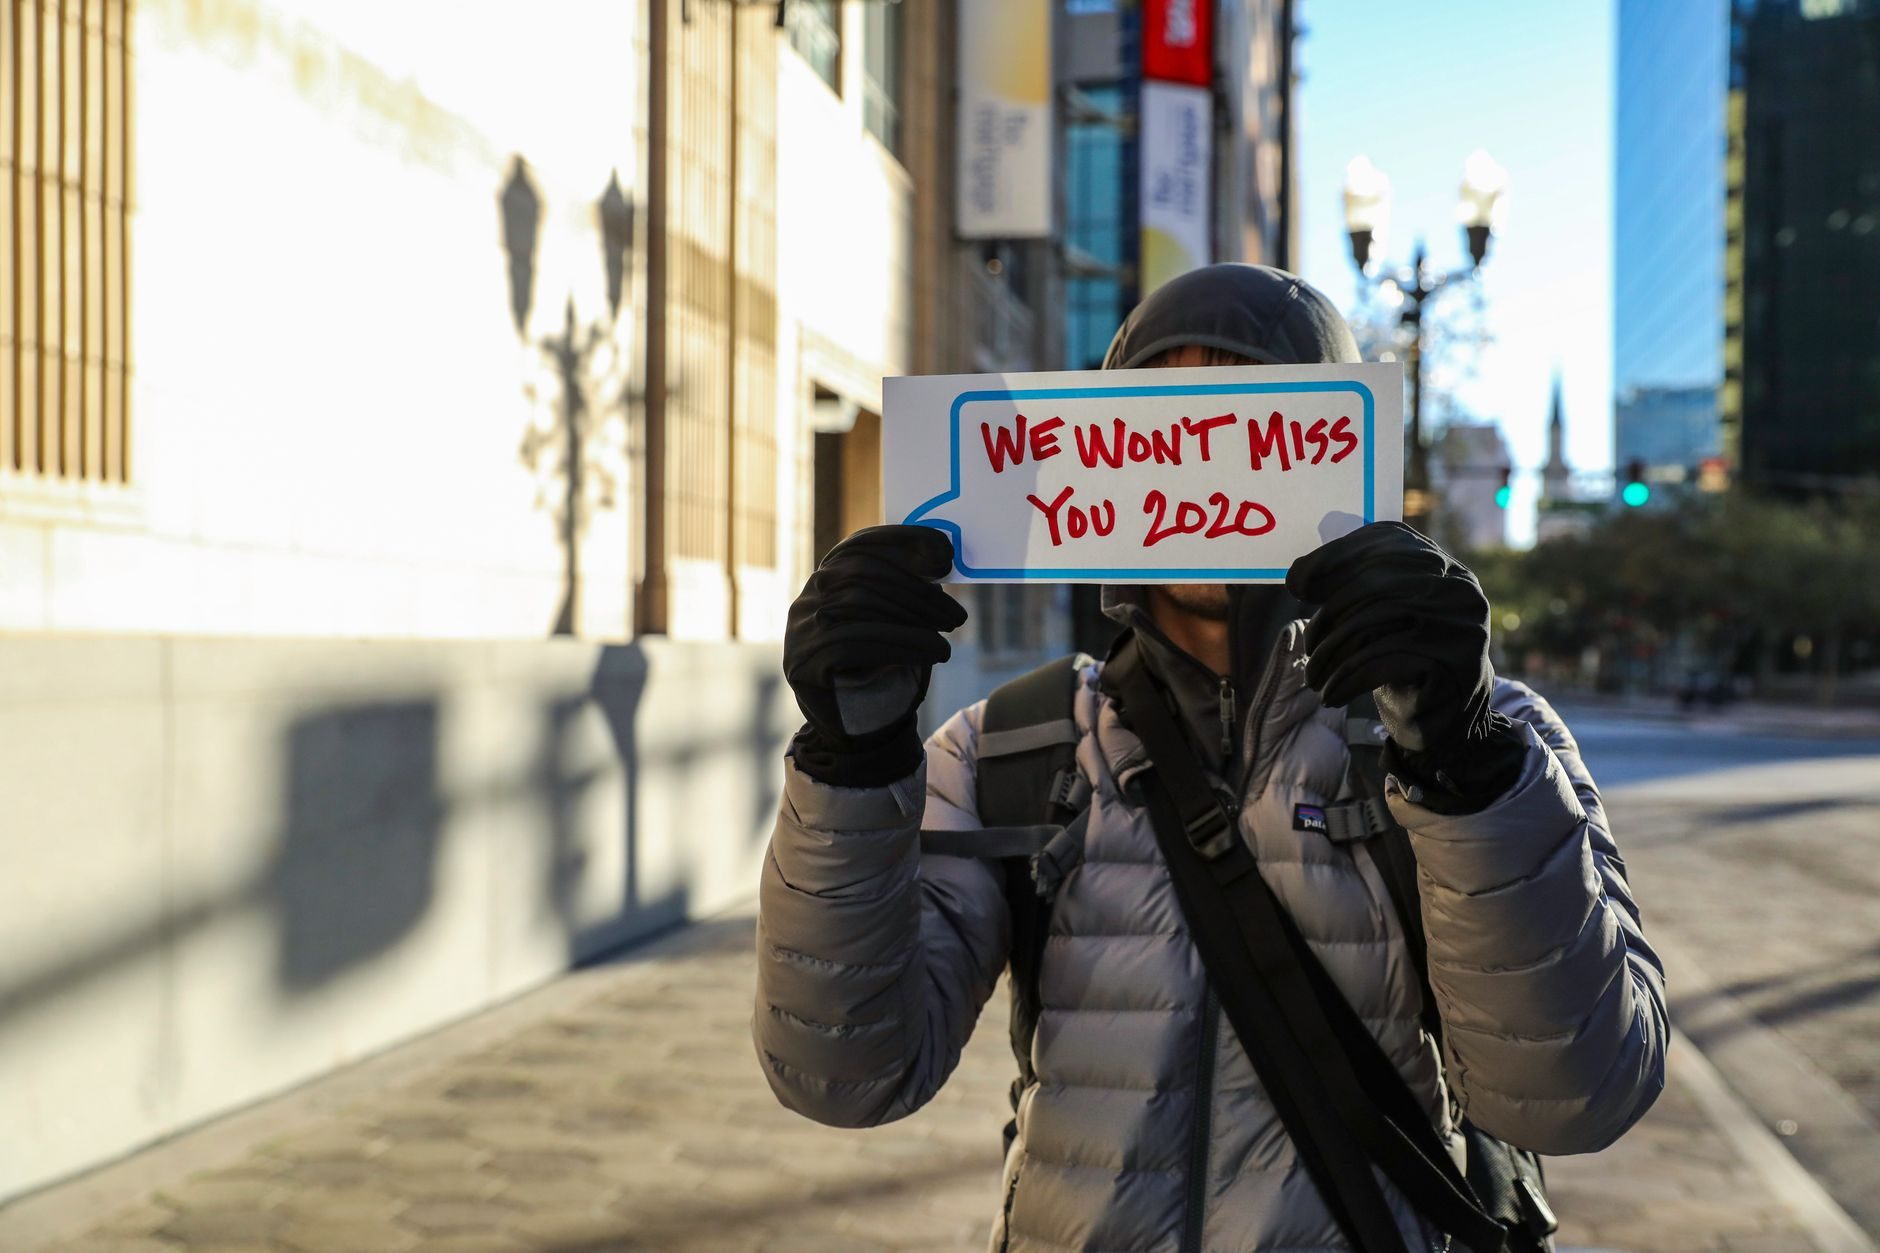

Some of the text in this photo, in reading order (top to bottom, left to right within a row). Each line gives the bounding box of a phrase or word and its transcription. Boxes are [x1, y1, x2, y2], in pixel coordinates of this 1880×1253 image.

[981, 411, 1359, 474] WE WON'T MISS
[1026, 485, 1277, 548] YOU 2020
